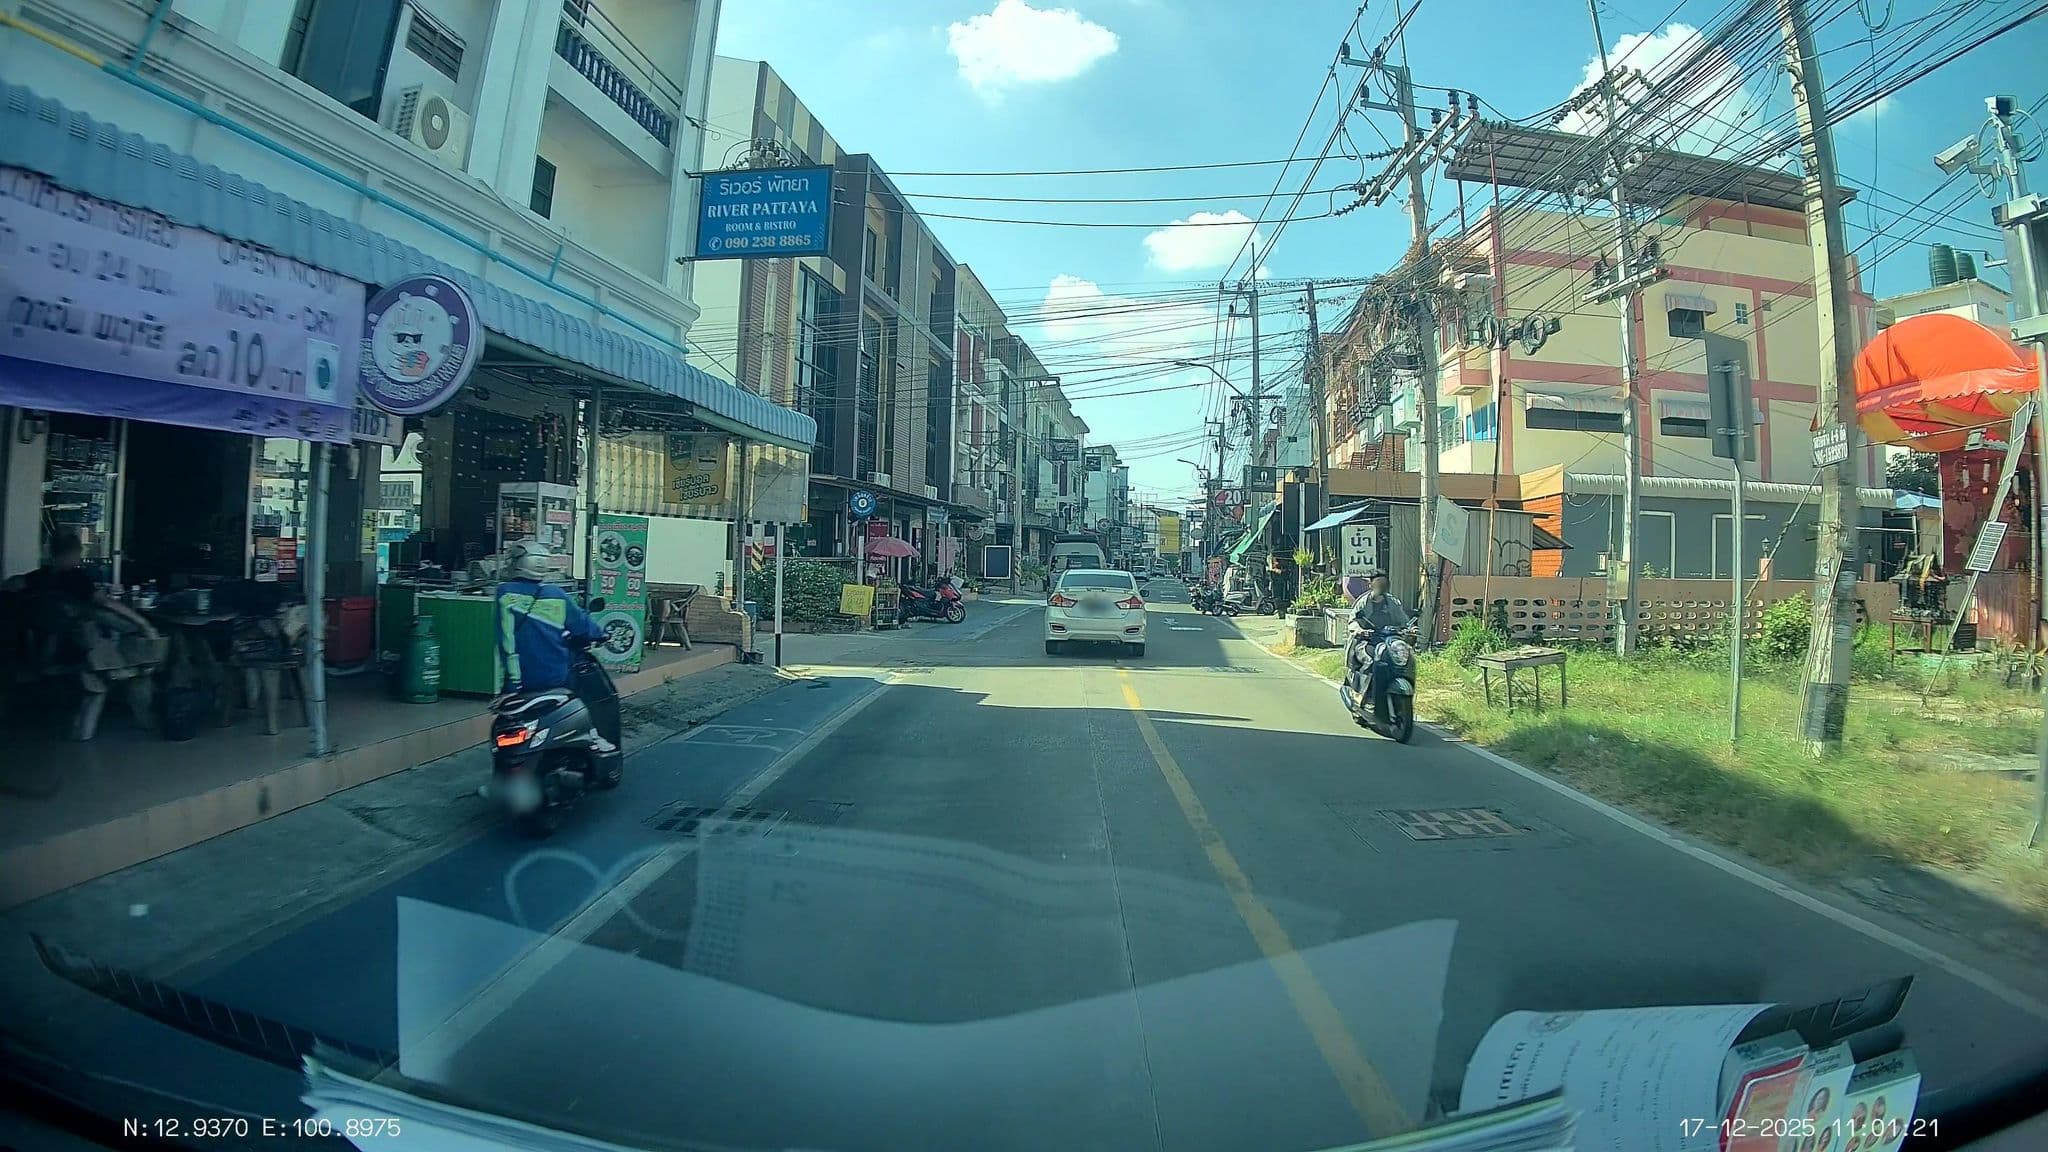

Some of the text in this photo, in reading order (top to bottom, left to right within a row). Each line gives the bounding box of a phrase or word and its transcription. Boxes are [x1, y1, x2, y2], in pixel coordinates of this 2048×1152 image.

[768, 175, 808, 193] พัทยา
[707, 199, 817, 218] RIVER PATTAYA
[725, 220, 797, 232] ROOM & BISTRO
[725, 234, 811, 249] 090 238 8865
[213, 282, 279, 321] WASH
[302, 304, 337, 337] DRY
[229, 328, 265, 389] 10
[1350, 527, 1372, 547] น้ำ
[1350, 549, 1374, 566] มัน
